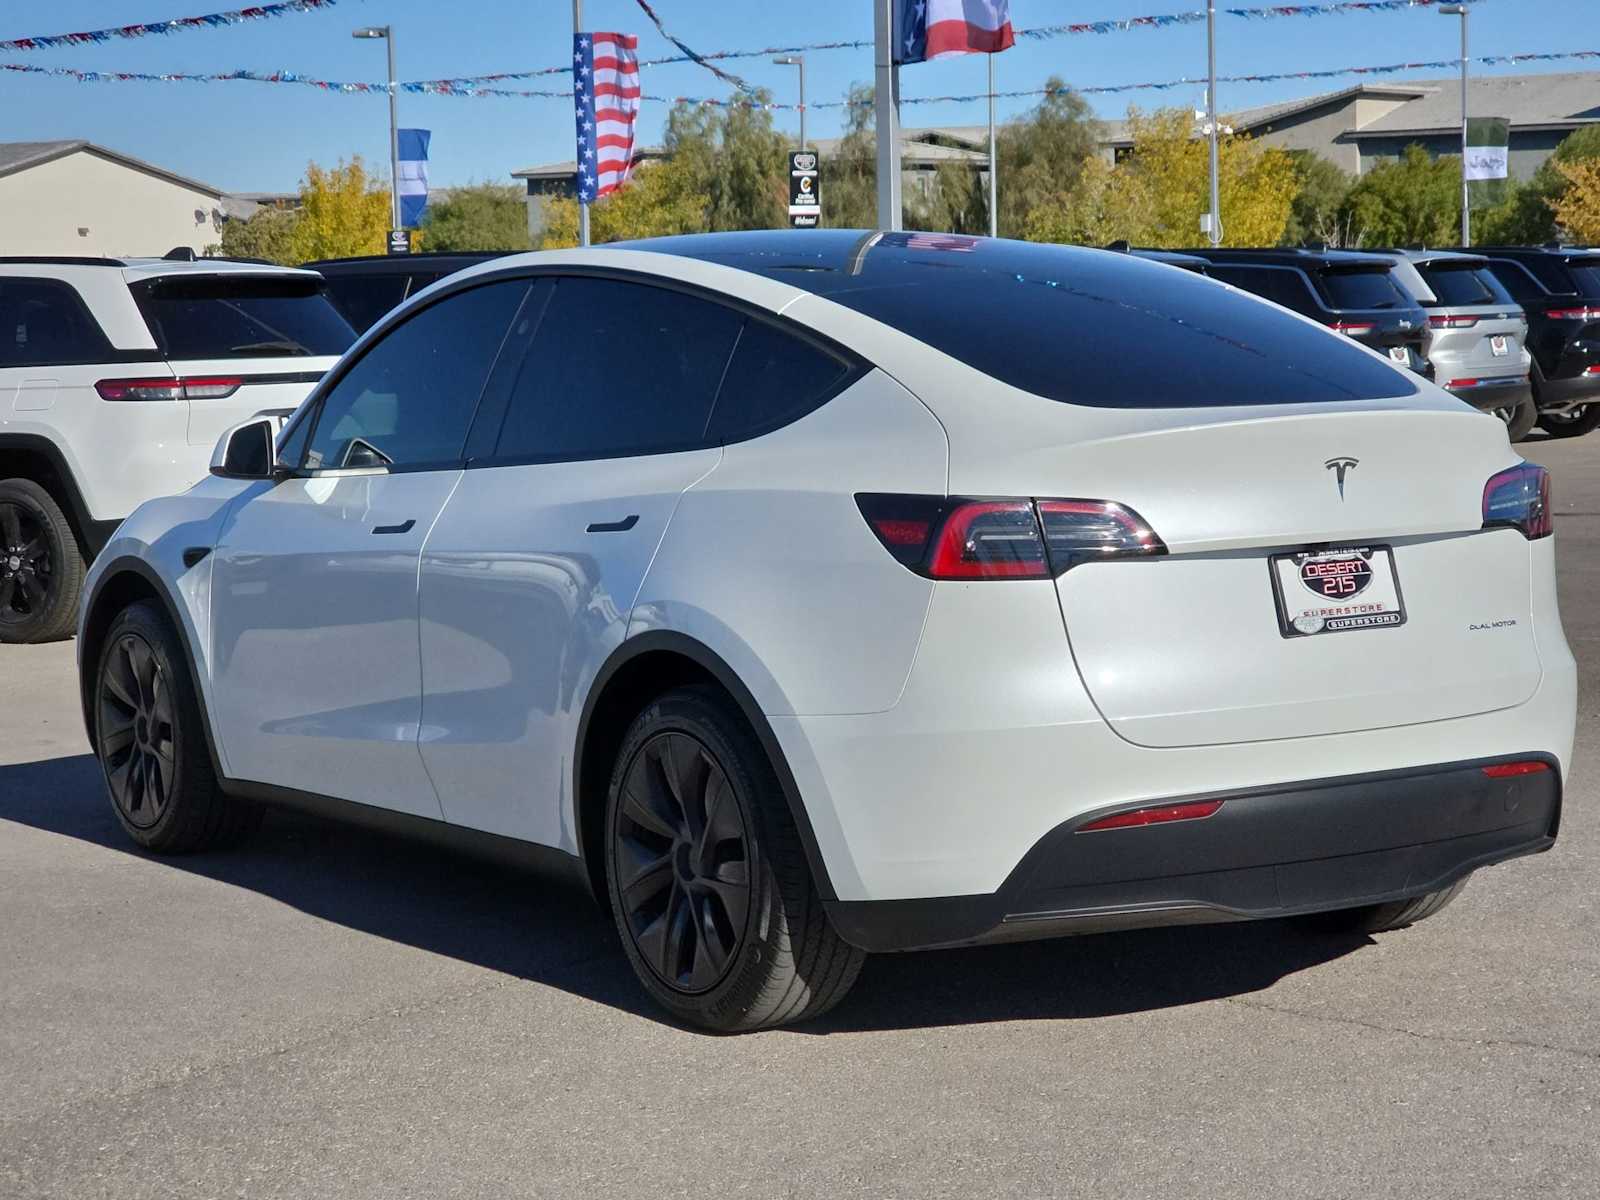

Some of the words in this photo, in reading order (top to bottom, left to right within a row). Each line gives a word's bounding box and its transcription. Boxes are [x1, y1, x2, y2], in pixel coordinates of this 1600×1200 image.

[1305, 560, 1364, 577] DESERT
[1323, 576, 1357, 594] 215
[1303, 603, 1384, 617] SUPERSTORE
[1330, 614, 1397, 628] SUPERSTORE
[1469, 623, 1491, 631] DUAL
[1491, 619, 1517, 628] MOTOR
